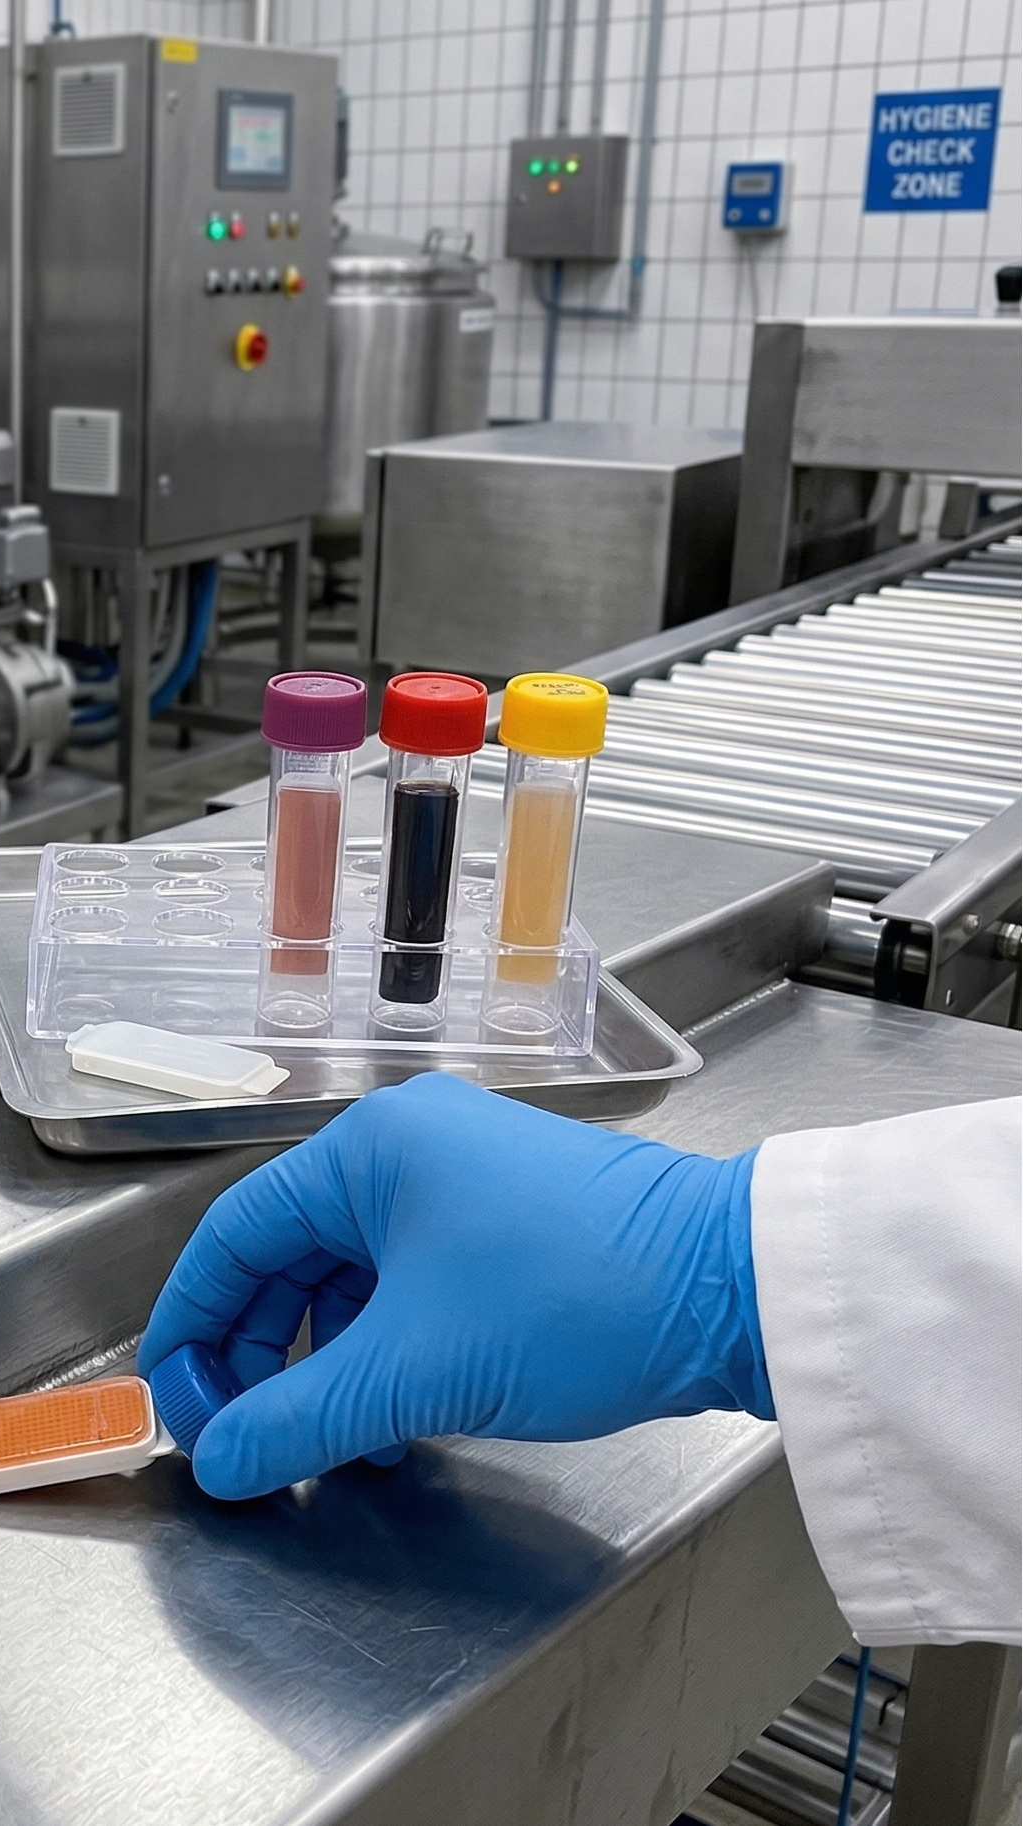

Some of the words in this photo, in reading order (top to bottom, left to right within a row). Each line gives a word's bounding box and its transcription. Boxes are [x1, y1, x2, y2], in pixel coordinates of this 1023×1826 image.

[878, 102, 993, 133] HYGIENE
[887, 137, 976, 167] CHECK
[891, 171, 964, 200] ZONE
